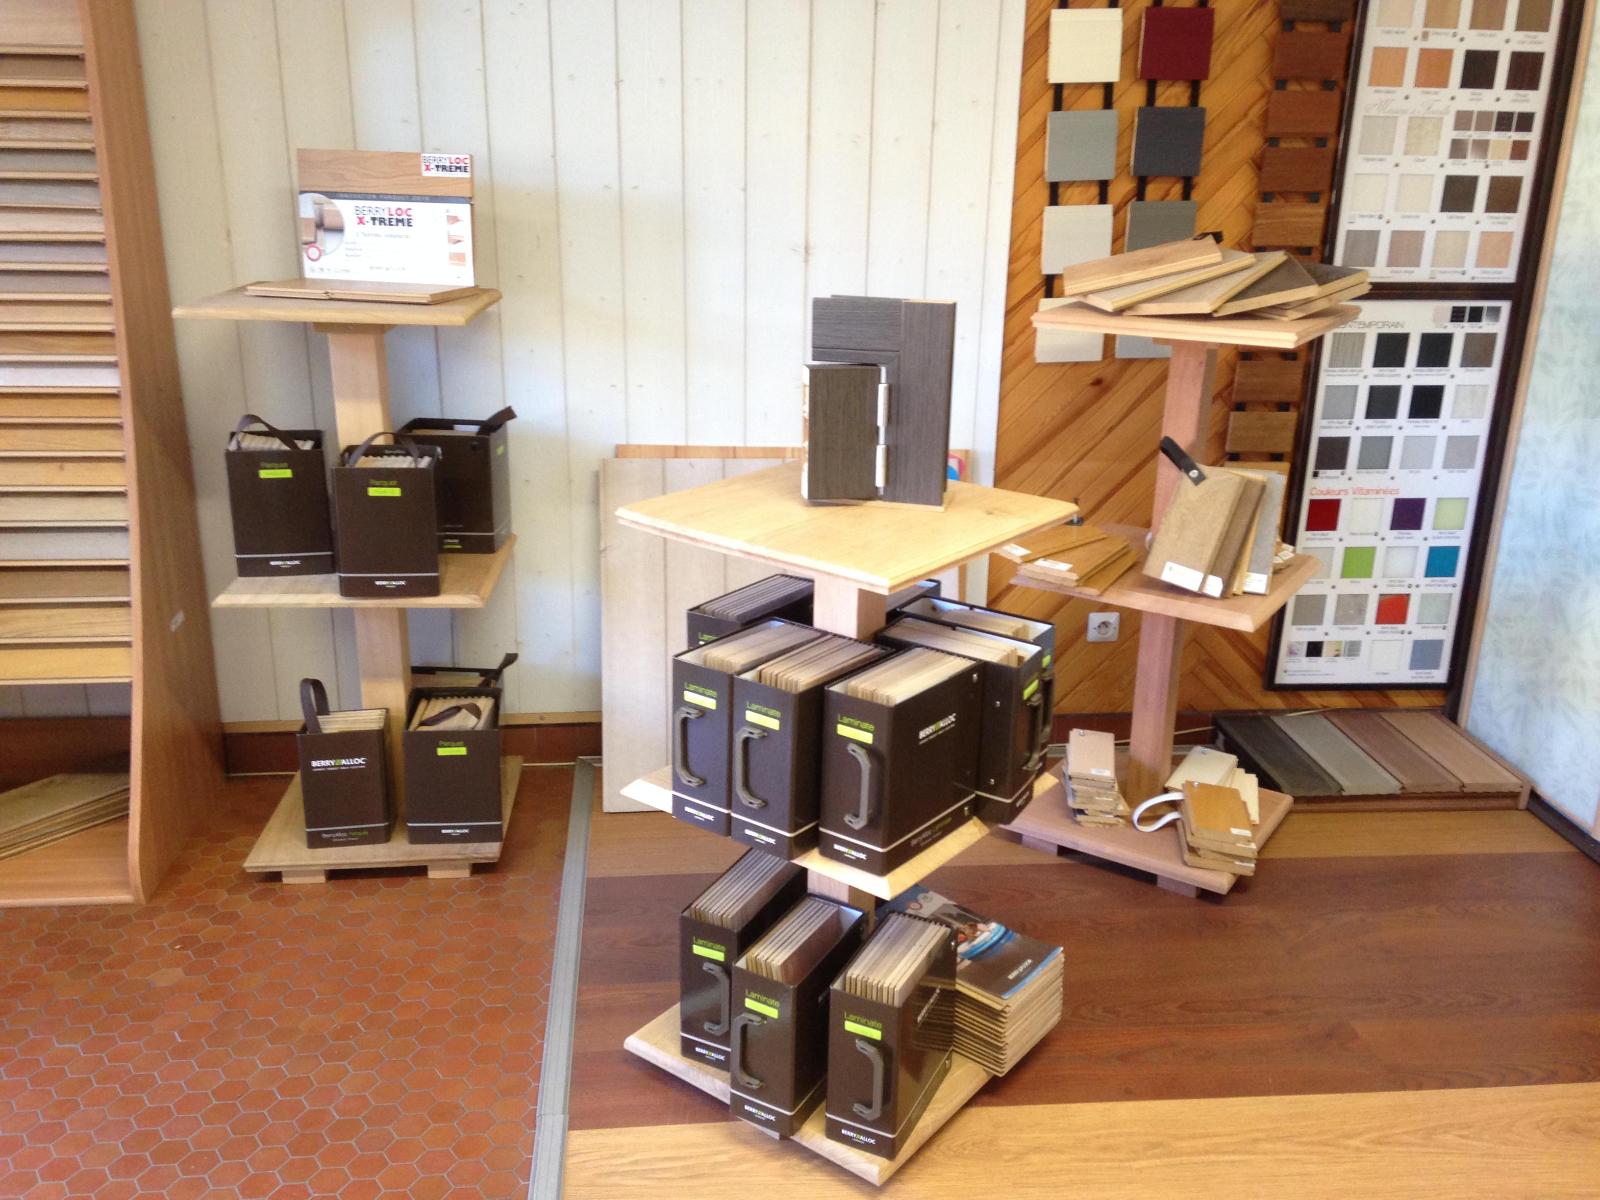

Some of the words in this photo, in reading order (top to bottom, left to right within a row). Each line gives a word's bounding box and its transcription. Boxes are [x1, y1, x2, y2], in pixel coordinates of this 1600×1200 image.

[424, 163, 468, 173] X-TREME
[356, 216, 413, 227] X-TREME
[684, 682, 717, 698] Laminate
[746, 701, 781, 718] Laminate
[838, 714, 874, 731] Laminate
[693, 936, 726, 952] Laminate
[745, 989, 780, 1008] Laminate
[844, 1011, 882, 1029] Laminate
